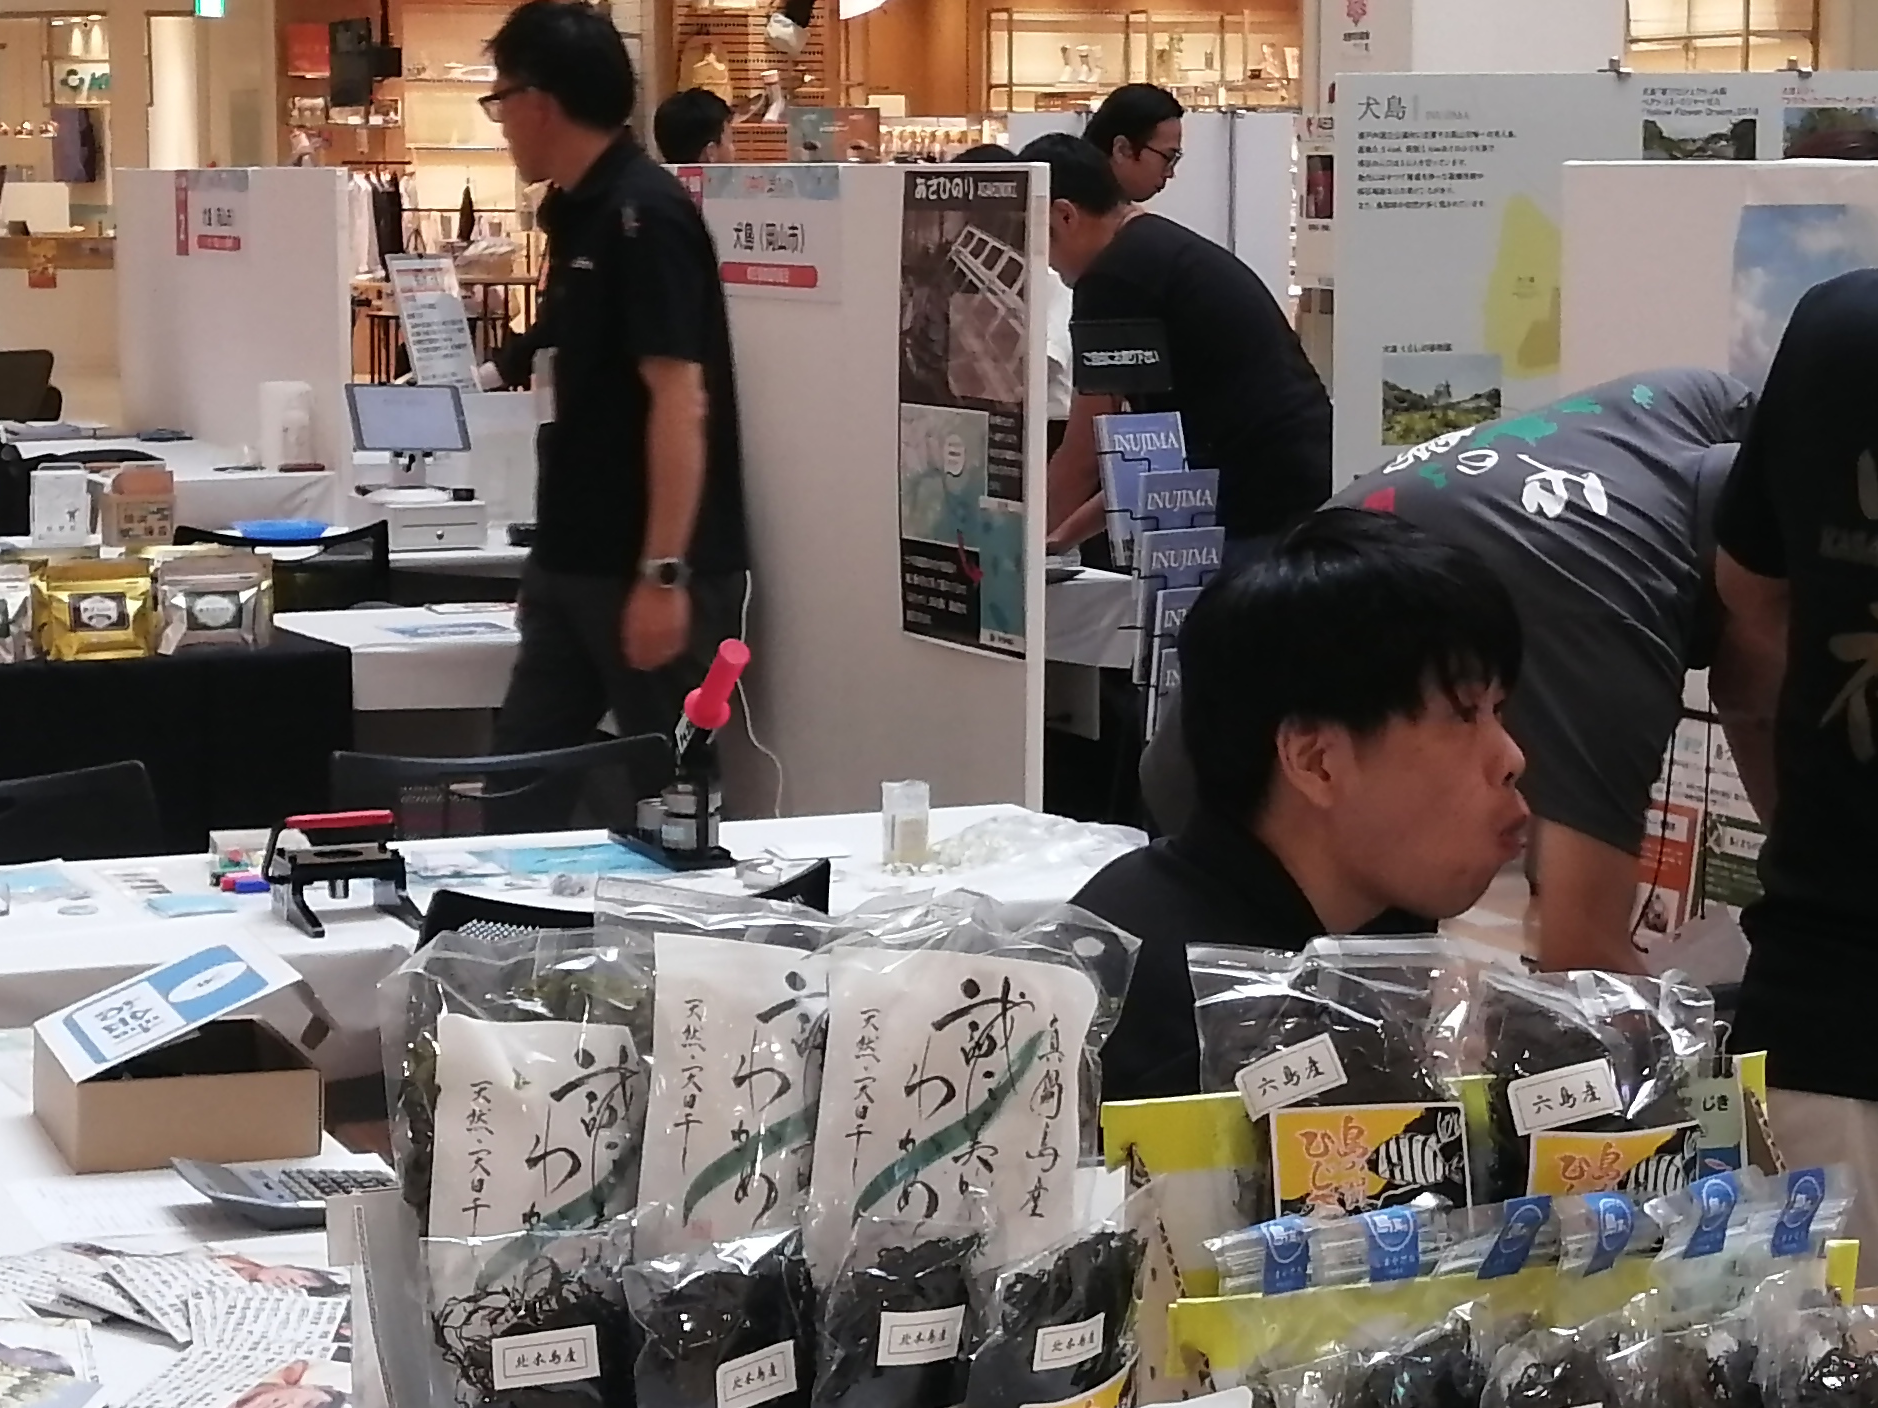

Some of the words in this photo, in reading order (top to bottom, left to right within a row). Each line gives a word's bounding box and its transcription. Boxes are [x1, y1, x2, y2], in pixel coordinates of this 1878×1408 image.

[1358, 95, 1407, 120] 犬島
[1114, 431, 1180, 455] INUJIMA
[1147, 488, 1214, 513] INUJIMA
[1151, 546, 1220, 570] INUJIMA
[1258, 1053, 1327, 1099] 六島産
[1532, 1084, 1603, 1115] 六島産
